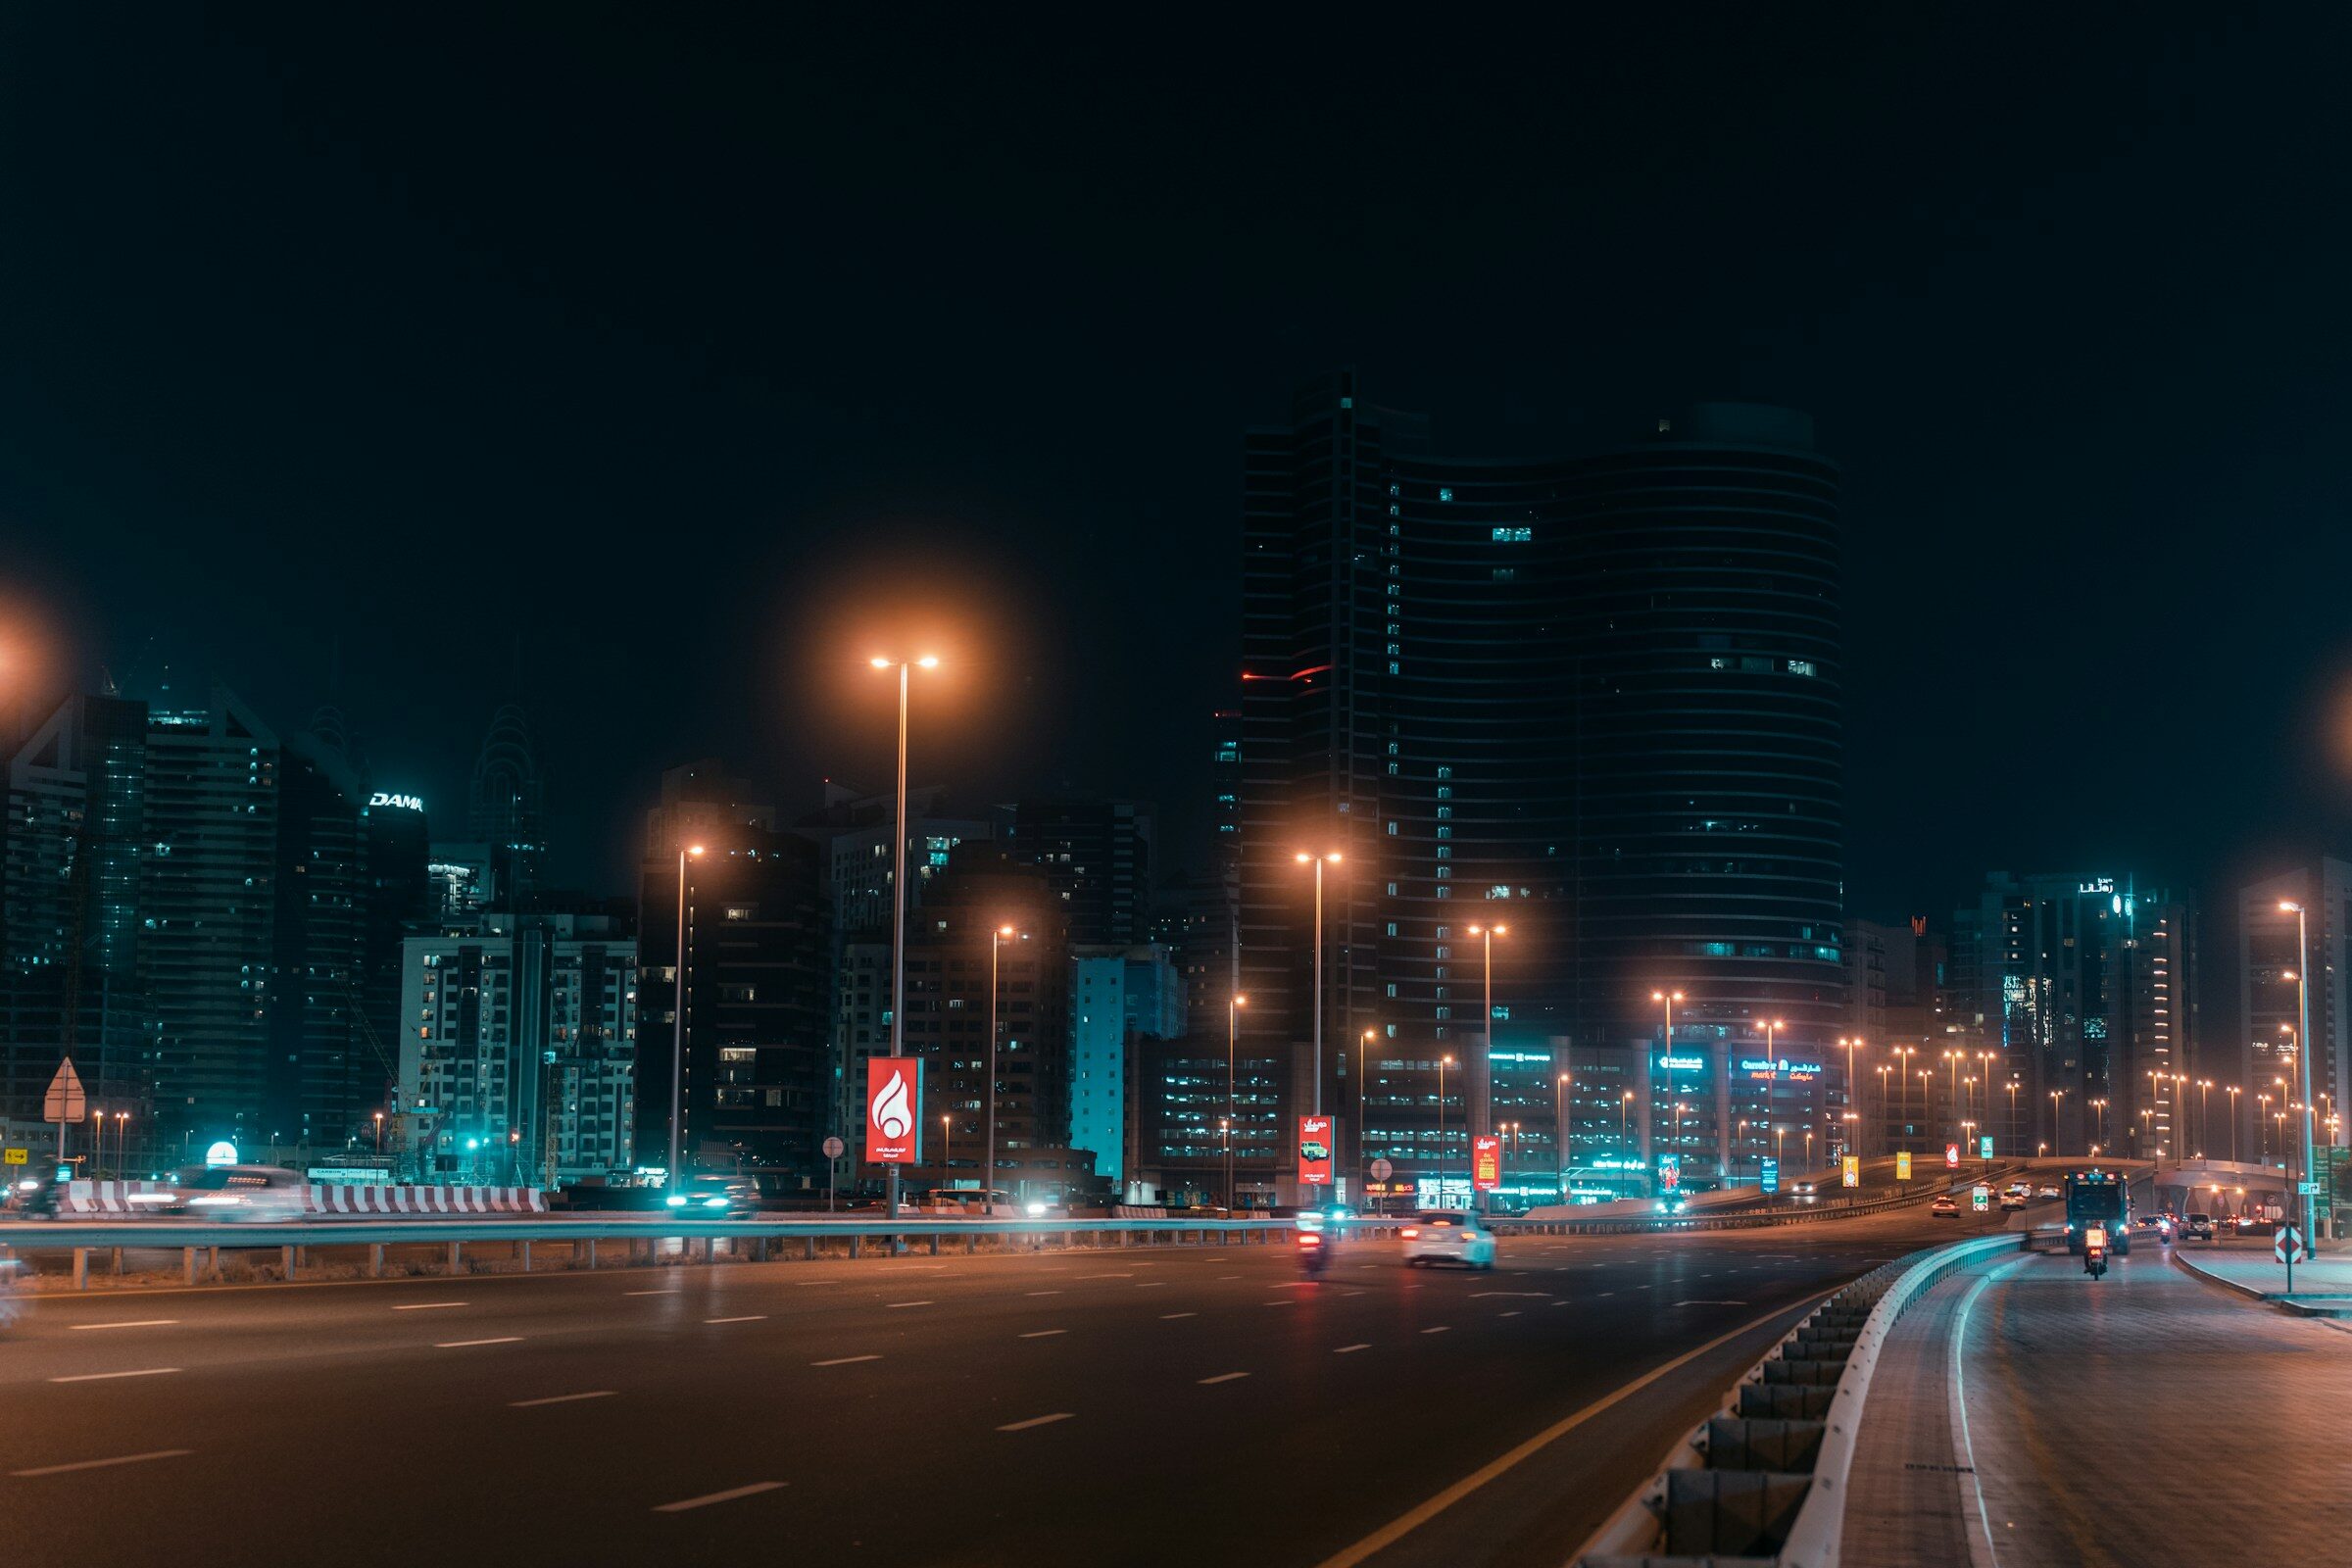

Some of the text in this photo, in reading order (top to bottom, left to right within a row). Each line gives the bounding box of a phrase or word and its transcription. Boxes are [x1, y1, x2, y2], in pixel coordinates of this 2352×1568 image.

[369, 793, 423, 812] DAMA
[2080, 883, 2114, 894] روتانا
[1741, 1059, 1778, 1070] Carrefor
